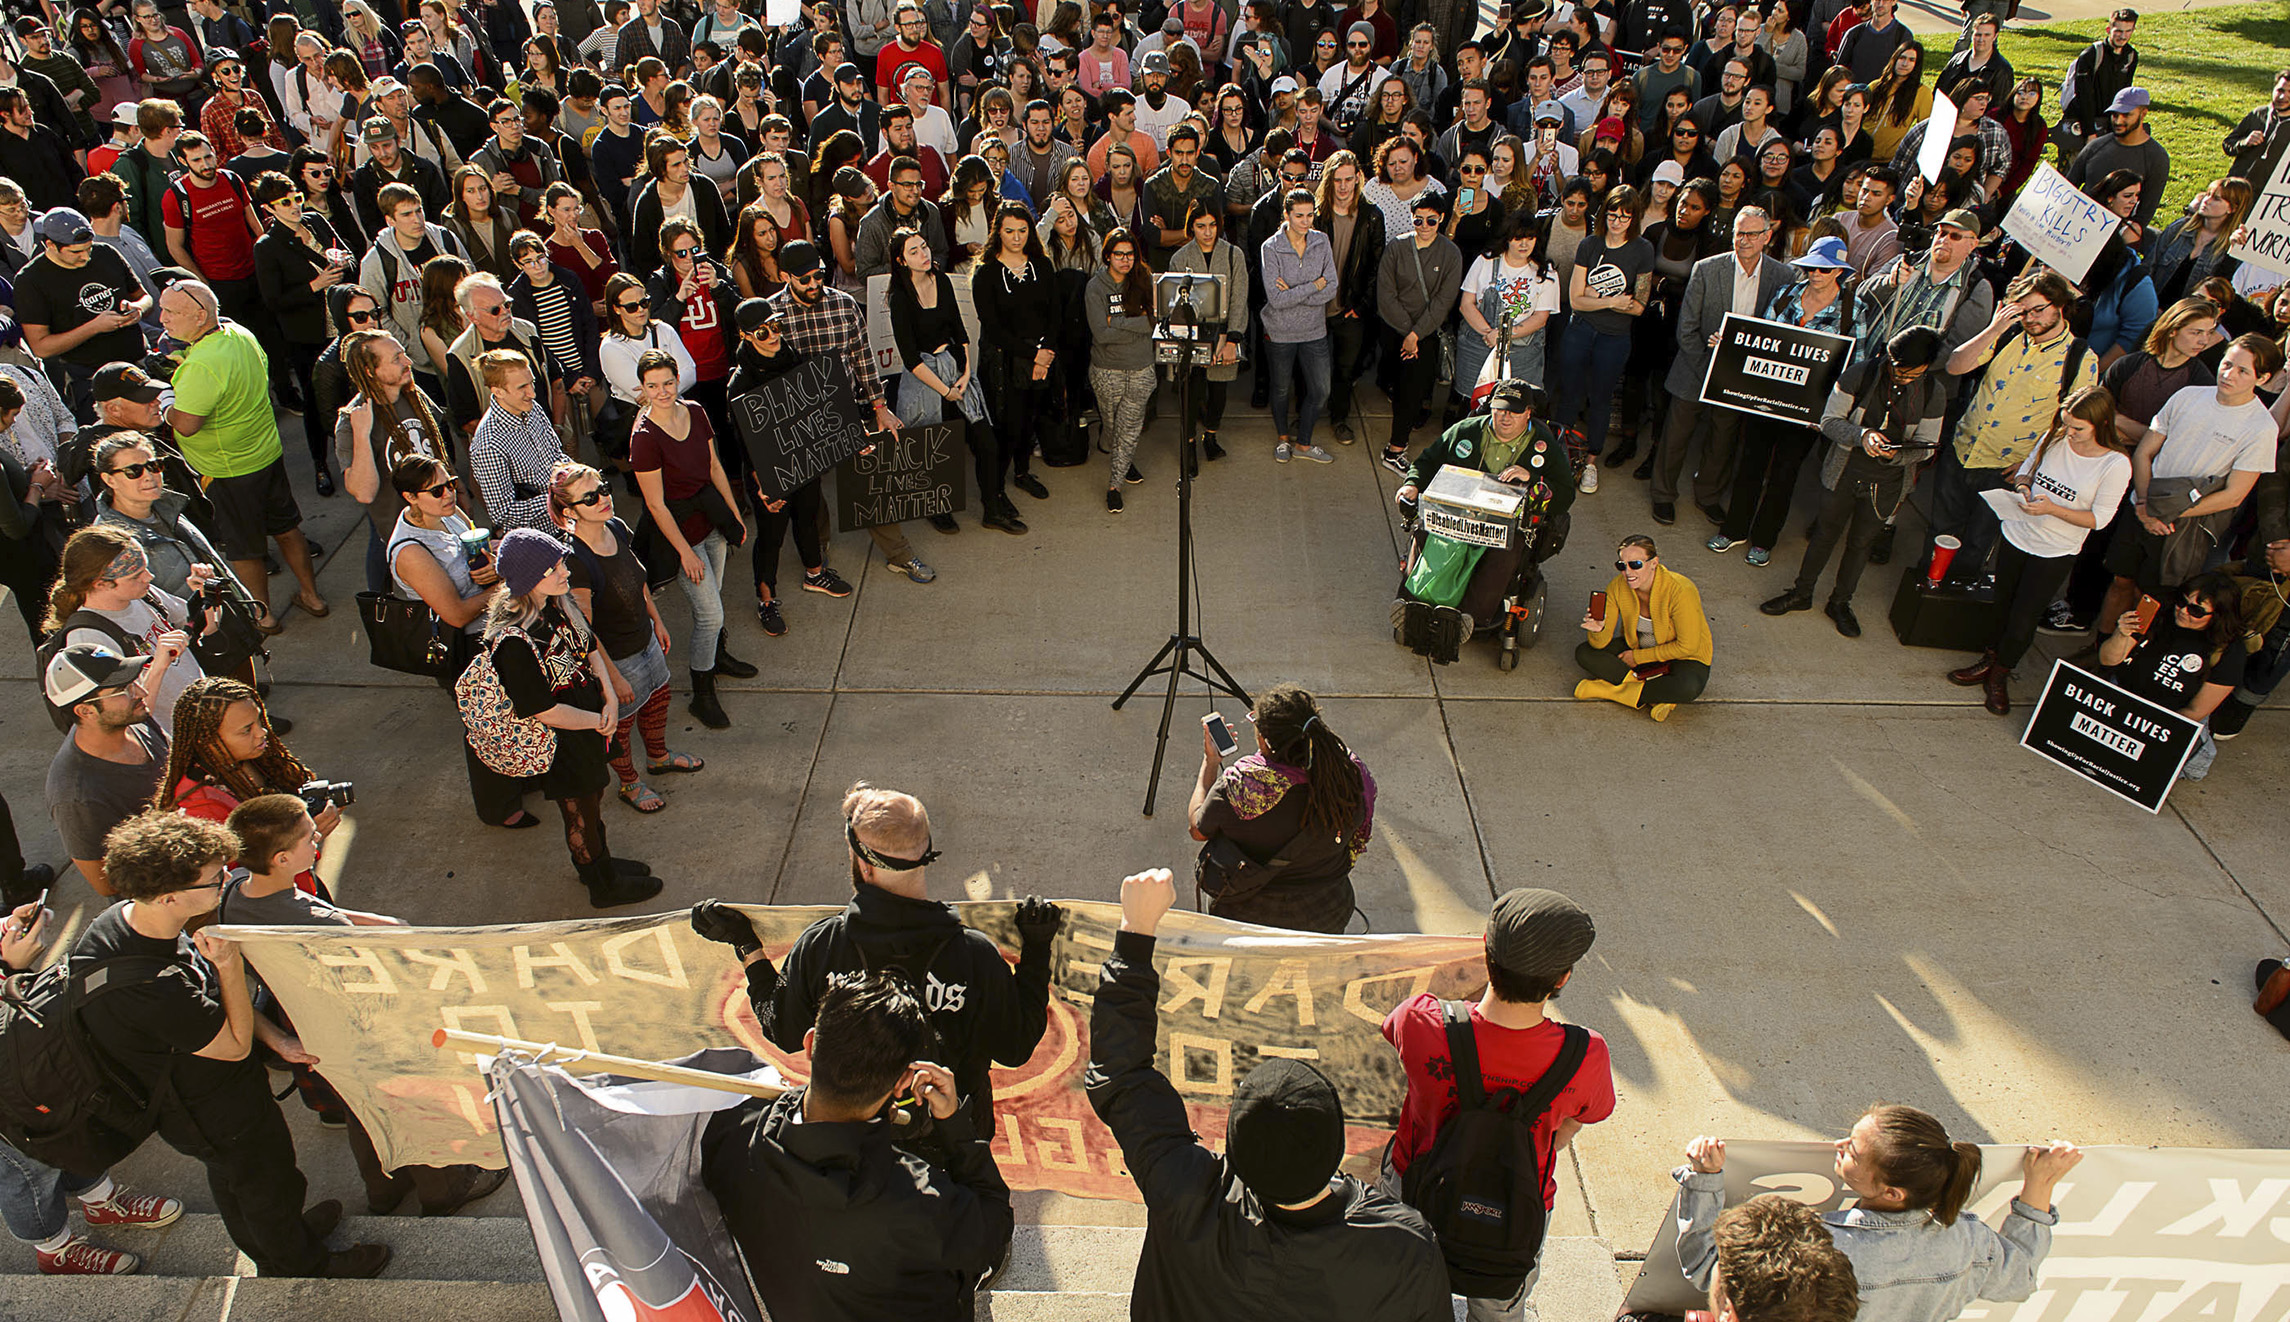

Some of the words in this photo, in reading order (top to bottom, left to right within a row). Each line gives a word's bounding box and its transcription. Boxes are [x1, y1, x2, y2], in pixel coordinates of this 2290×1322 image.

[2033, 169, 2115, 232] BIGOTRY
[2040, 203, 2088, 243] KILLS
[1589, 271, 1611, 283] BLACK
[1734, 331, 1783, 353] BLACK
[1789, 343, 1831, 363] LIVES
[1749, 360, 1804, 382] MATTER
[741, 355, 839, 434] BLACK
[1722, 388, 1810, 414] ShowingUpForRacialJustice.org
[773, 400, 843, 456] LIVES
[773, 421, 872, 492] MATTER
[853, 425, 952, 475] BLACK
[868, 470, 933, 495] LIVES
[854, 483, 953, 527] MATTER
[1426, 511, 1507, 540] #DisabledLivesMatter!
[2064, 683, 2116, 717] BLACK
[2123, 712, 2171, 743] LIVES
[2078, 717, 2139, 756] MATTER
[2046, 739, 2141, 792] ShowingUpForRacialJustice.org
